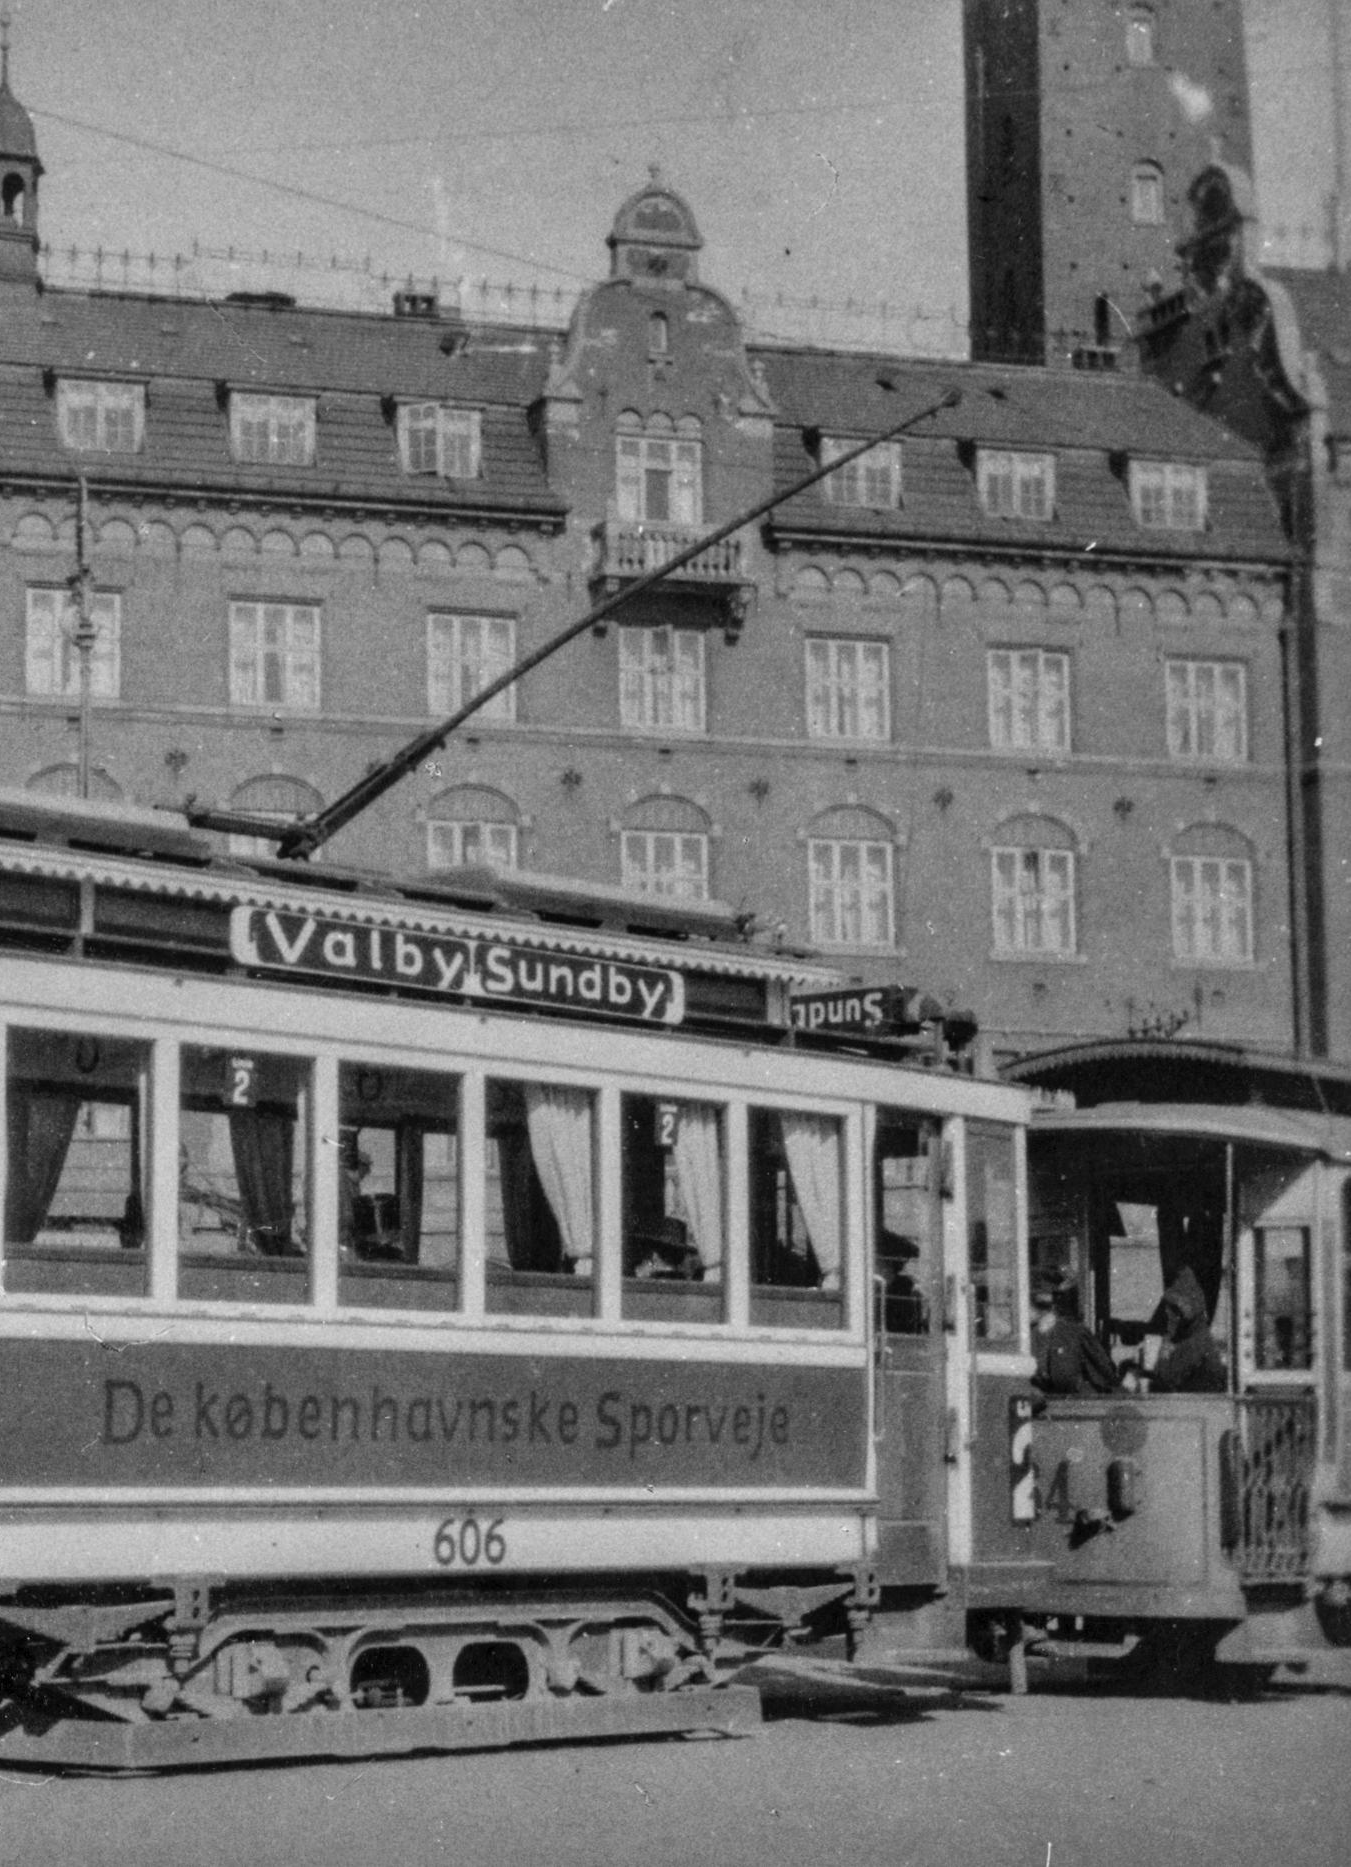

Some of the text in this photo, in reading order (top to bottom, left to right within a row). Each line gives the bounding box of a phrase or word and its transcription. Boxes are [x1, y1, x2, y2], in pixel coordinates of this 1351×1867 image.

[265, 911, 665, 1019] Valby Sundby
[232, 1070, 250, 1105] 2
[660, 1113, 675, 1145] 2
[102, 1378, 789, 1461] De københavnske Sporveje
[434, 1518, 506, 1566] 606
